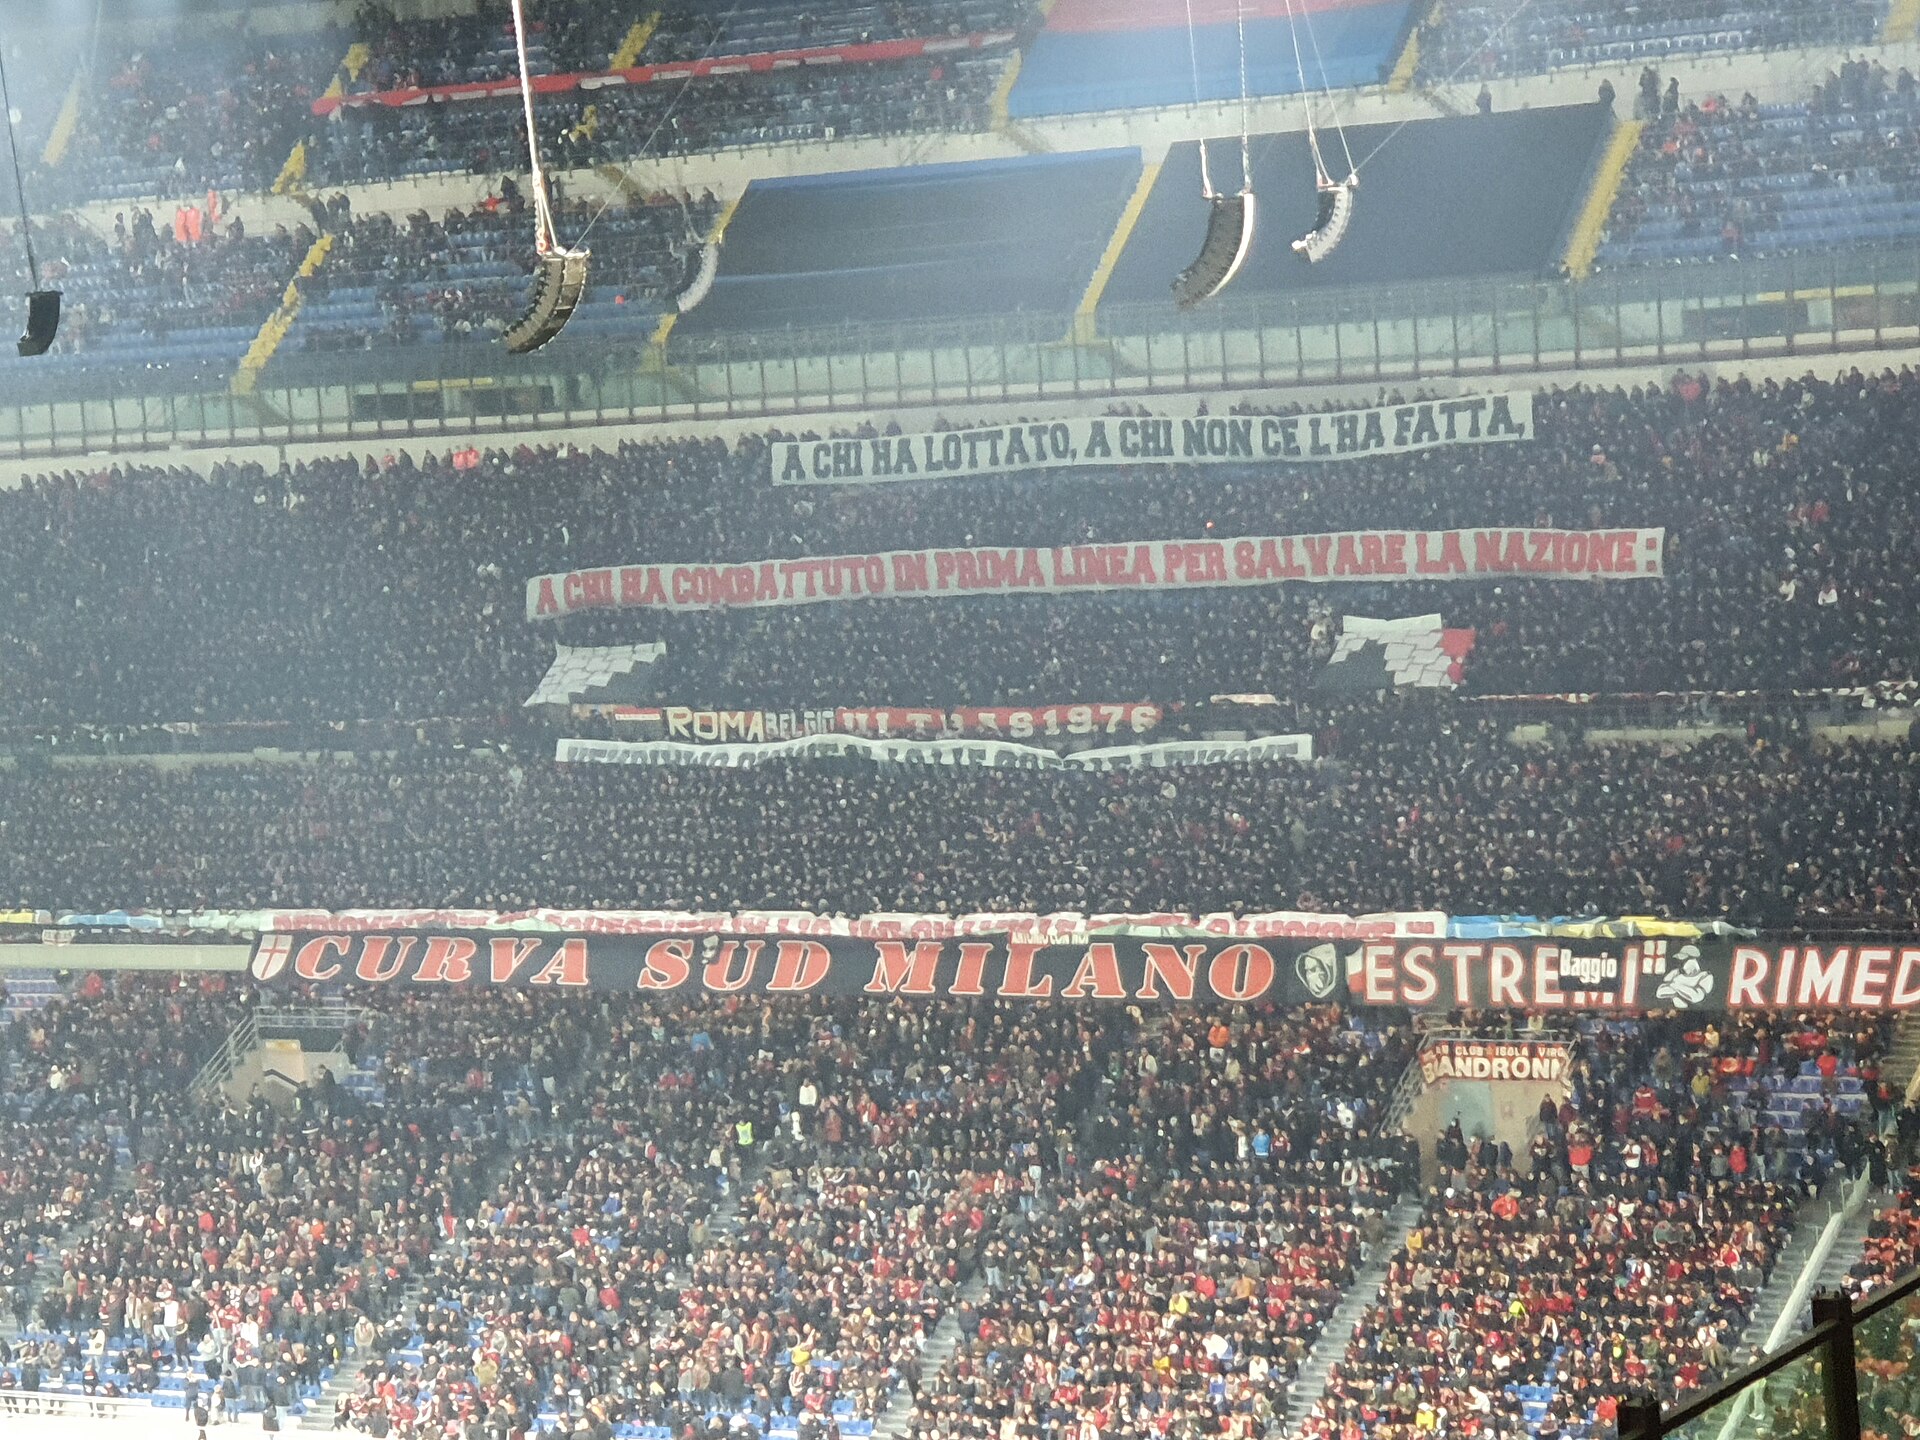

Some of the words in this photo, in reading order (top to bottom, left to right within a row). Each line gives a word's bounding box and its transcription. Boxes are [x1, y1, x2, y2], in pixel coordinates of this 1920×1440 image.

[782, 445, 806, 481] A
[813, 441, 863, 478] CHI
[872, 438, 917, 475] HA
[924, 422, 1077, 472] LOTTATO,
[1084, 420, 1112, 457] A
[1119, 419, 1174, 457] CHI
[1183, 418, 1253, 457] NON
[1262, 418, 1301, 457] CE
[1393, 395, 1525, 446] FATTA,
[537, 578, 558, 615] A
[563, 570, 616, 610] CHI
[672, 555, 886, 605] COMBATTUTO
[935, 548, 1044, 590] PRIMA
[1053, 544, 1156, 586] LINEA
[1163, 542, 1227, 583] PER
[1234, 529, 1407, 578] SALVARE
[1416, 532, 1467, 573] LA
[664, 706, 764, 742] ROMA
[1043, 706, 1158, 736] 1976
[295, 935, 589, 986] CURVA
[637, 939, 831, 992] SUD
[863, 941, 1275, 1001] MILANO
[1364, 943, 1639, 1007] ESTREI
[1560, 949, 1617, 983] Baggio
